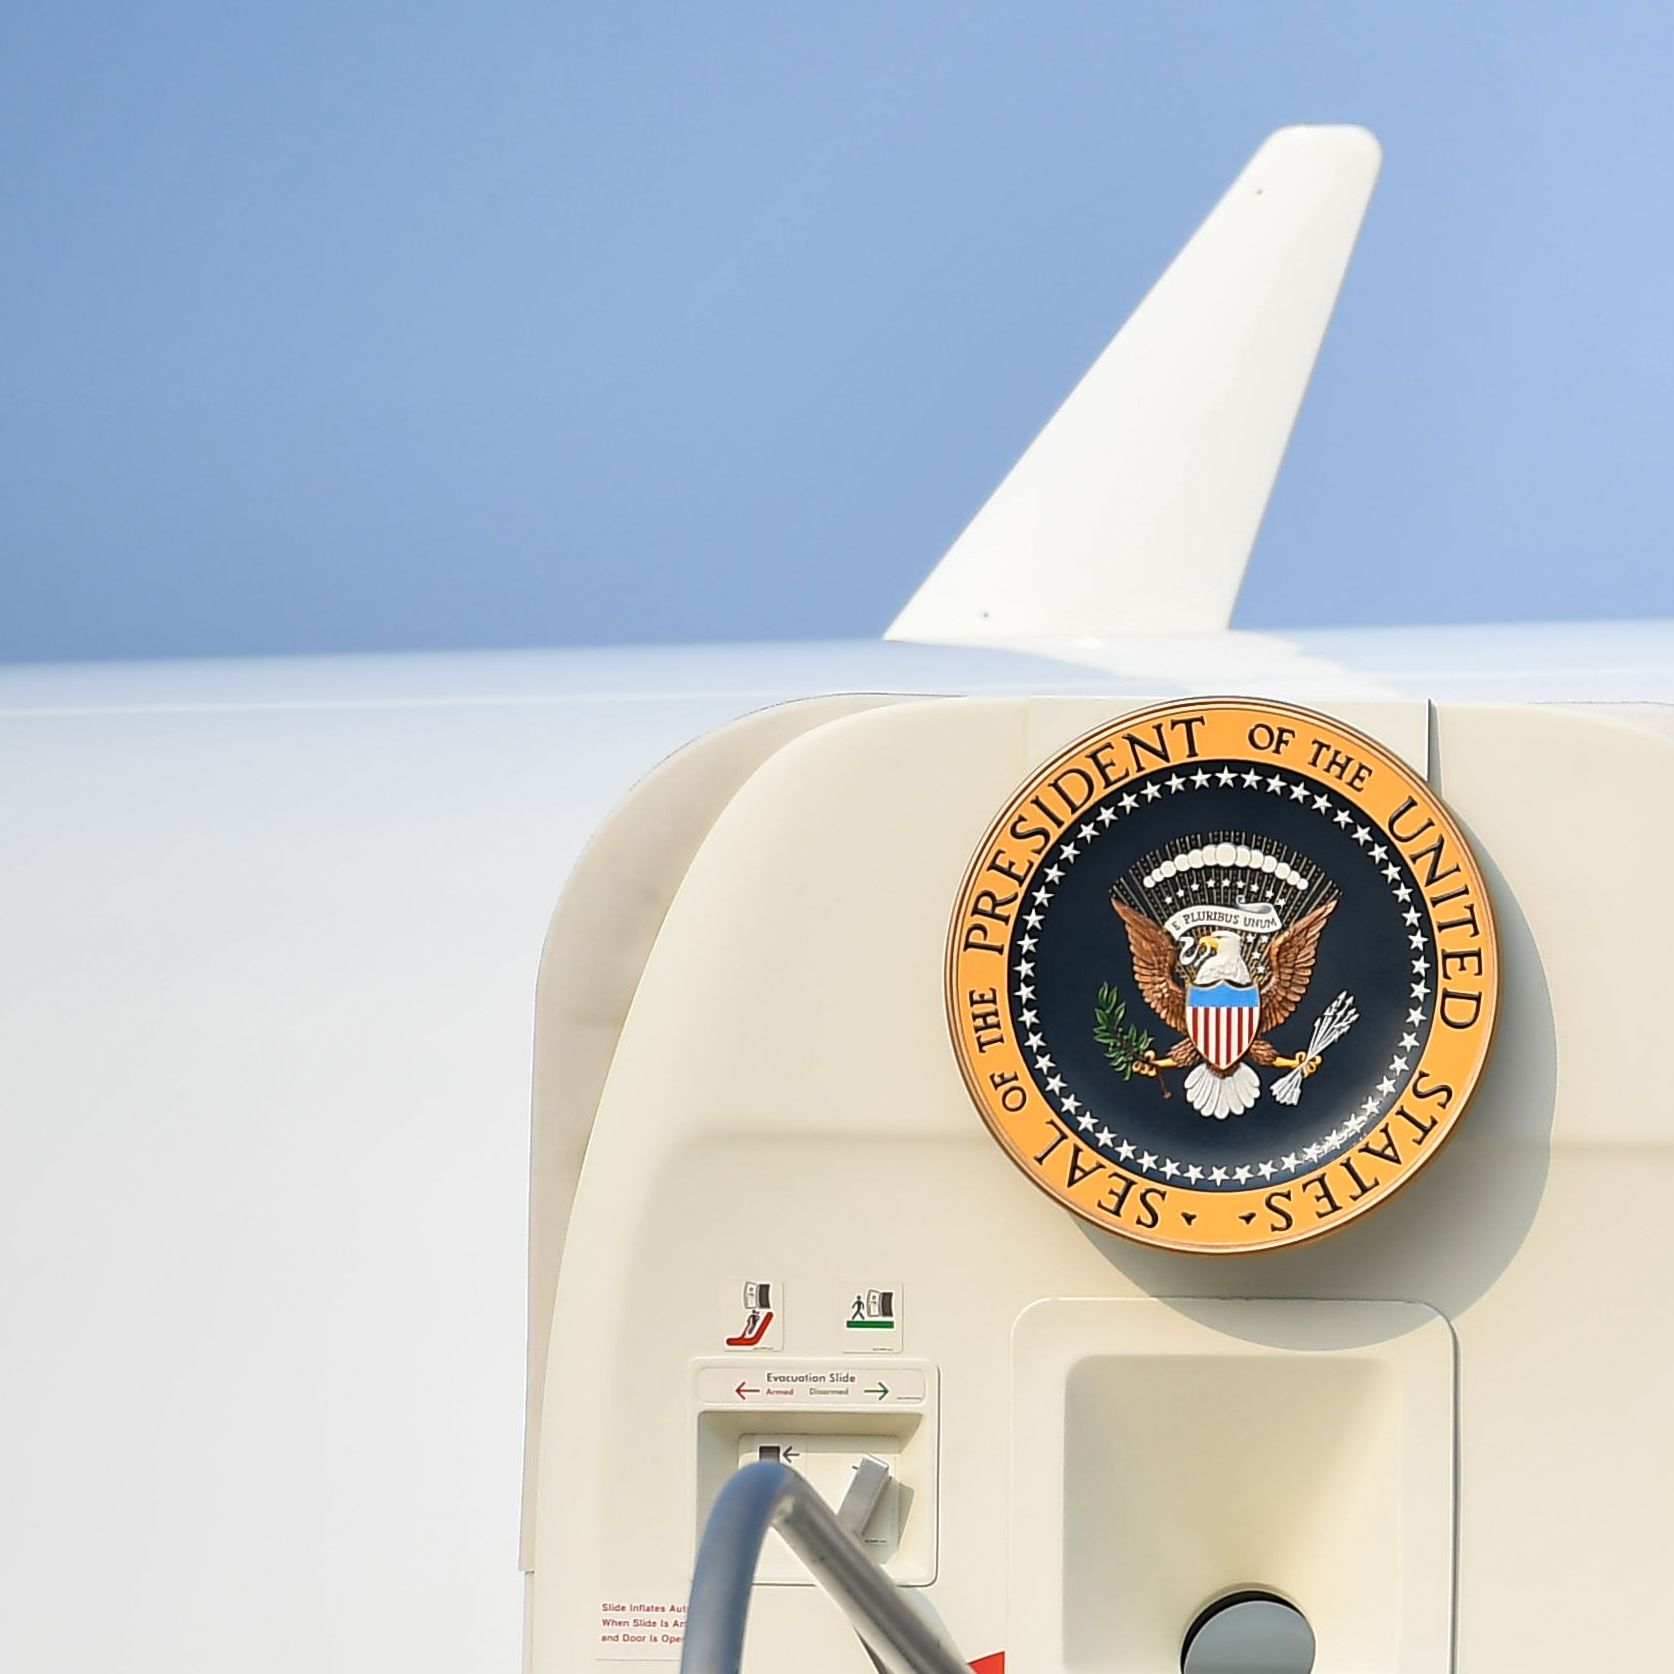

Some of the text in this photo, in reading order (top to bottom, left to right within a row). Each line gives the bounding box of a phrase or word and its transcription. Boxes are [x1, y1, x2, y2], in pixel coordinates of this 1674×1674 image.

[1171, 910, 1278, 931] E PLURIBUS UNUM
[963, 716, 1484, 1233] SEAL OF THE PRESIDENT OF THE UNITED STATES
[766, 1373, 856, 1383] Evacuation Slide
[766, 1387, 794, 1396] Armed
[602, 1603, 687, 1613] Slide Inflates Aut
[602, 1619, 629, 1627] When
[633, 1619, 657, 1627] Slide
[601, 1634, 619, 1642] and
[622, 1634, 646, 1642] Door
[650, 1634, 658, 1642] Is
